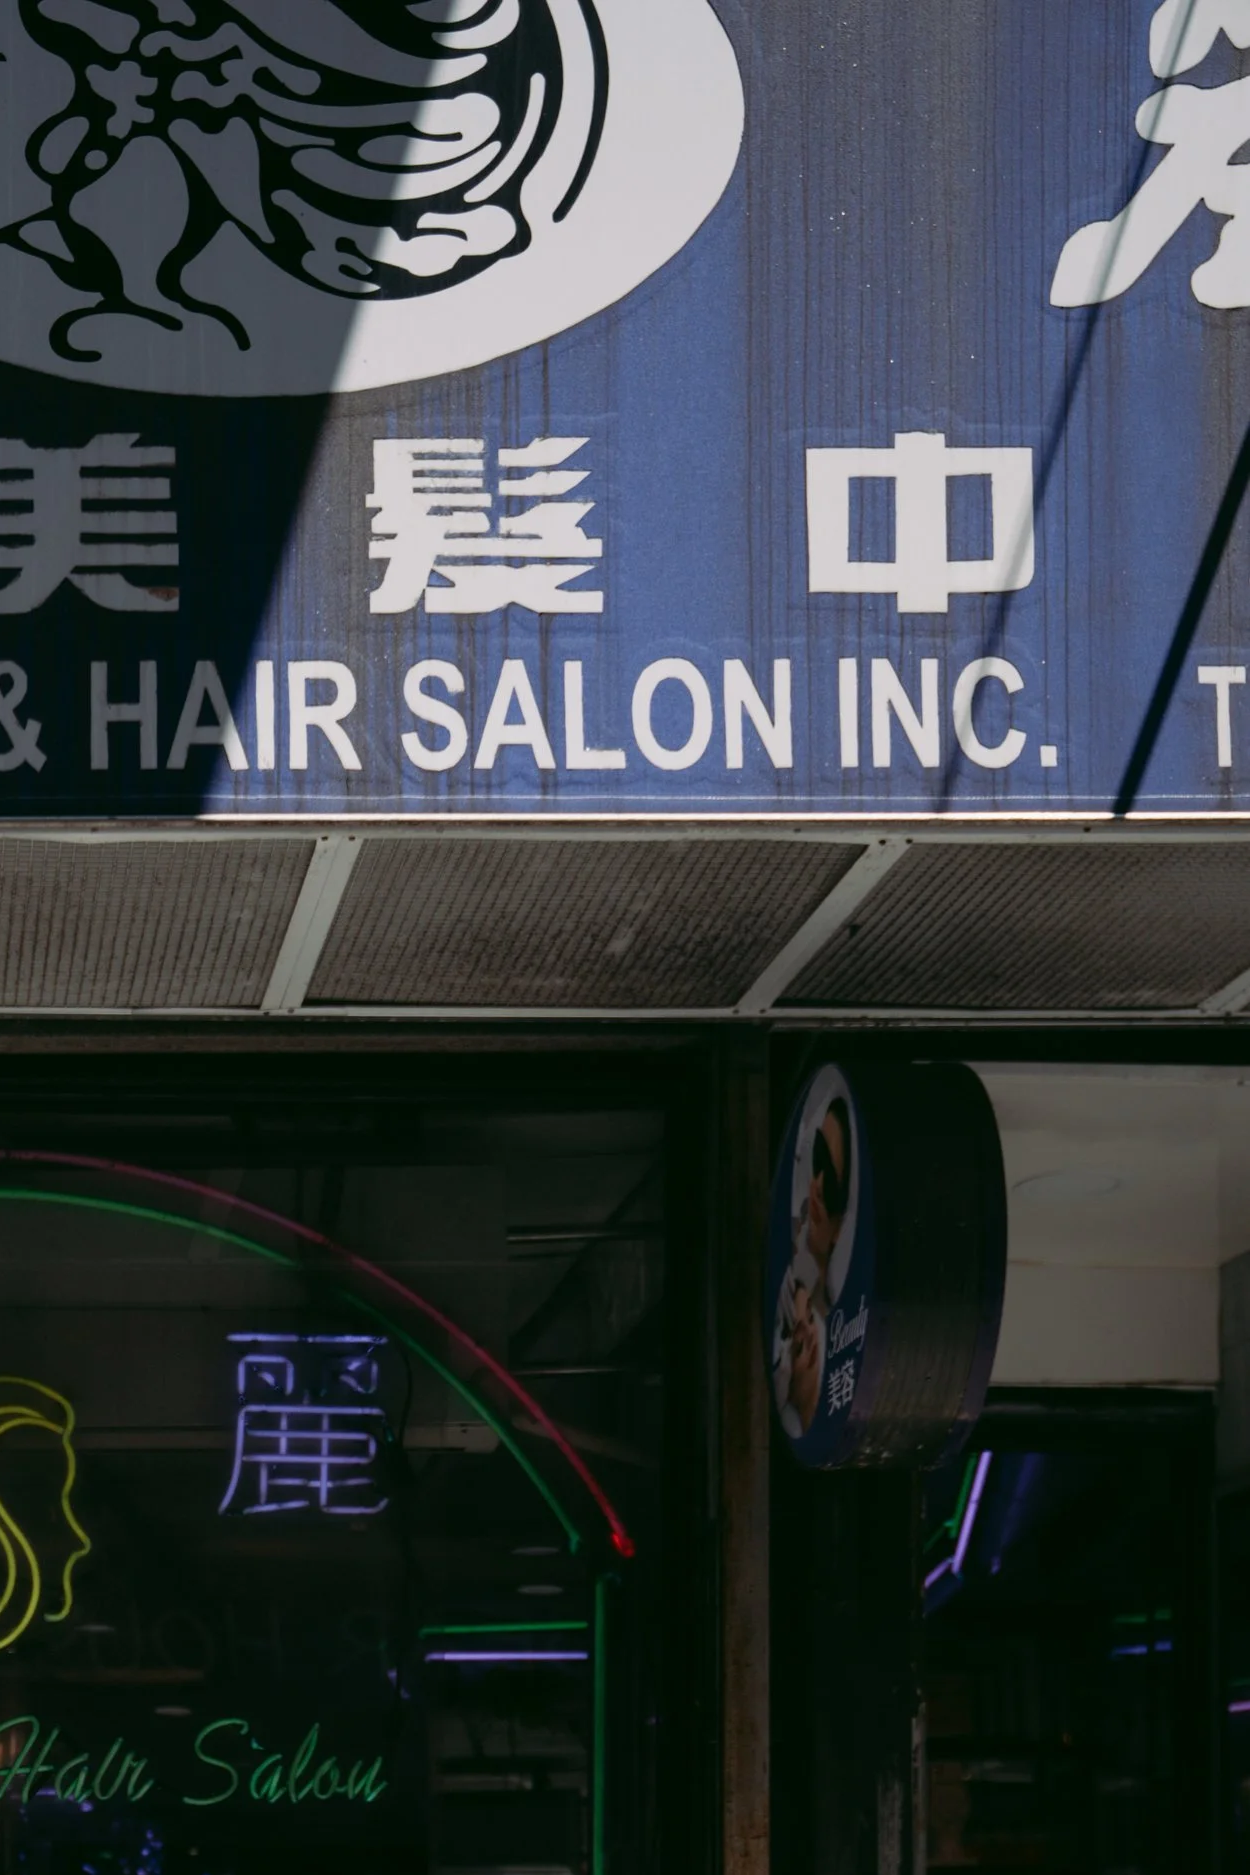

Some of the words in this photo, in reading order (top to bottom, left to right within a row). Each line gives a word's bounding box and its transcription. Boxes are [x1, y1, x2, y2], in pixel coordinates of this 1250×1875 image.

[89, 660, 362, 772] HAIR
[401, 656, 793, 772] SALON
[839, 655, 1059, 770] INC.
[1197, 665, 1247, 768] T
[828, 1293, 870, 1359] Beauty
[219, 1332, 388, 1515] 麗
[828, 1358, 855, 1417] 美容
[182, 1718, 388, 1804] Salon
